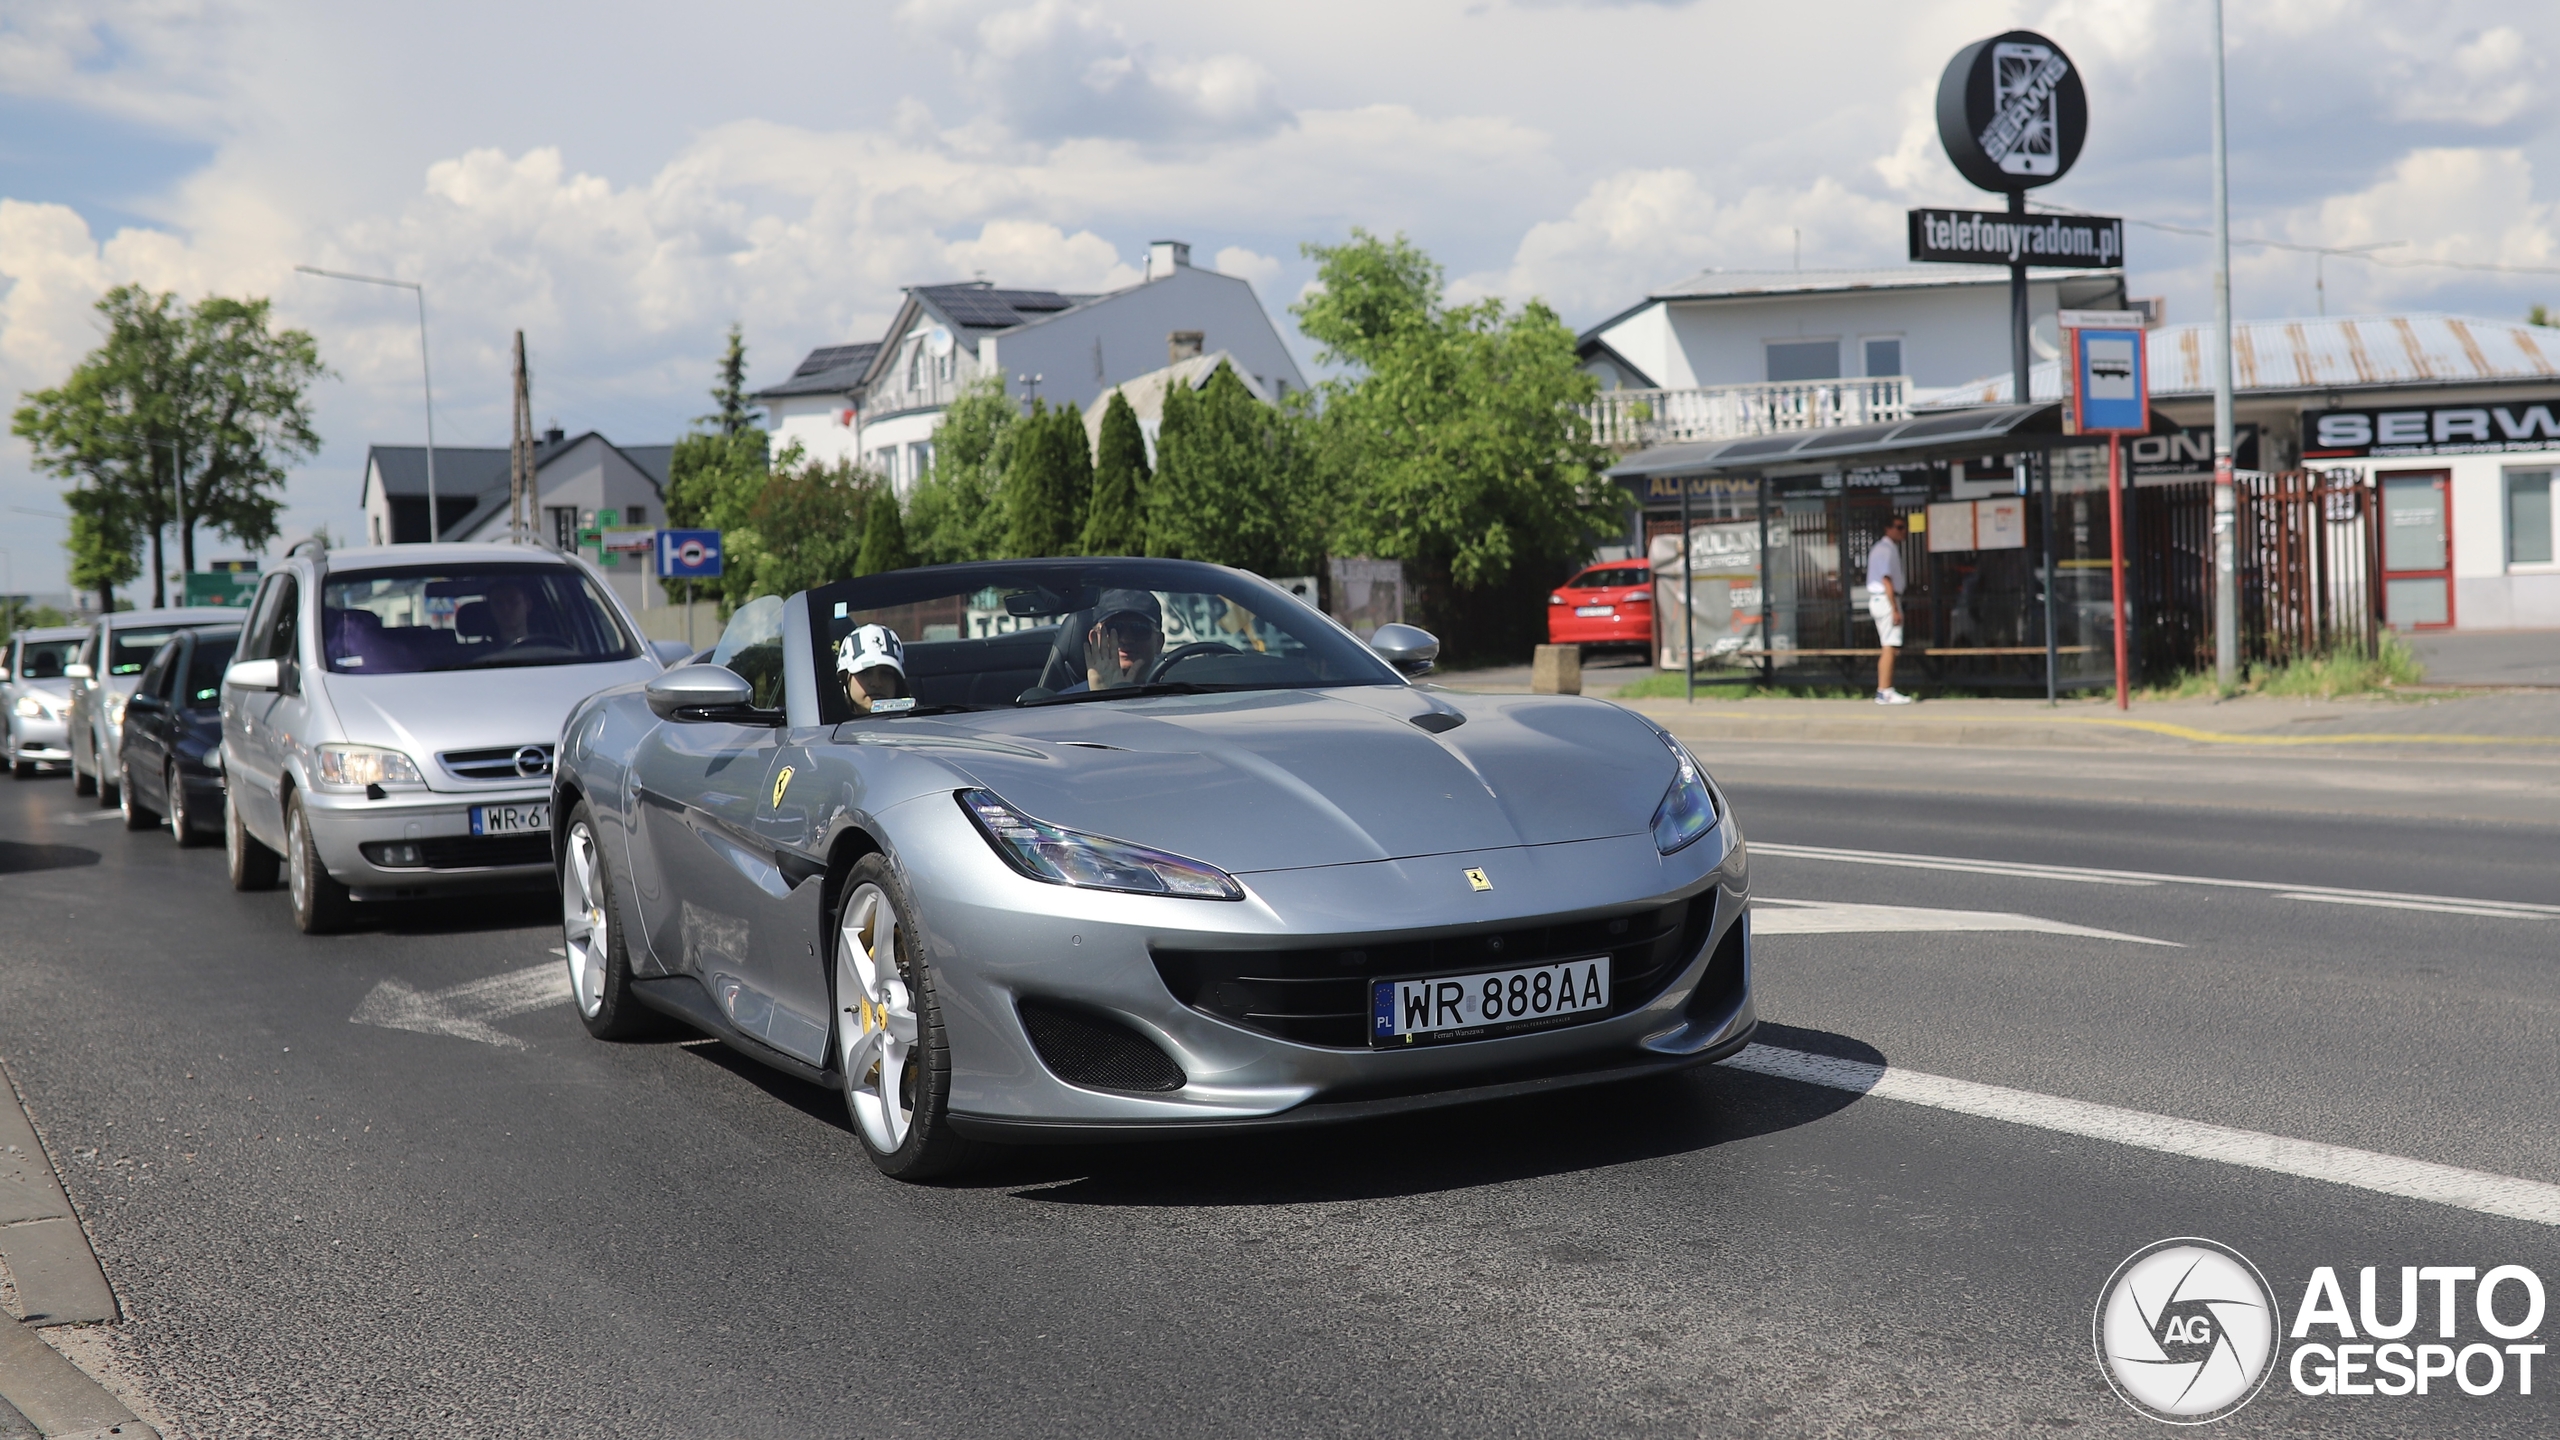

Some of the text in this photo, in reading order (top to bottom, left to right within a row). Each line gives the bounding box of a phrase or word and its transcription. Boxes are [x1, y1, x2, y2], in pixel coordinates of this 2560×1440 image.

[1984, 54, 2068, 163] SERWIS
[1925, 213, 2120, 265] telefonyradom.pl
[2317, 405, 2560, 447] SERW
[486, 806, 518, 830] WR
[1403, 963, 1602, 1029] WR 888AA
[1377, 1016, 1392, 1028] PL
[1433, 1028, 1484, 1039] Ferrari Warszawa
